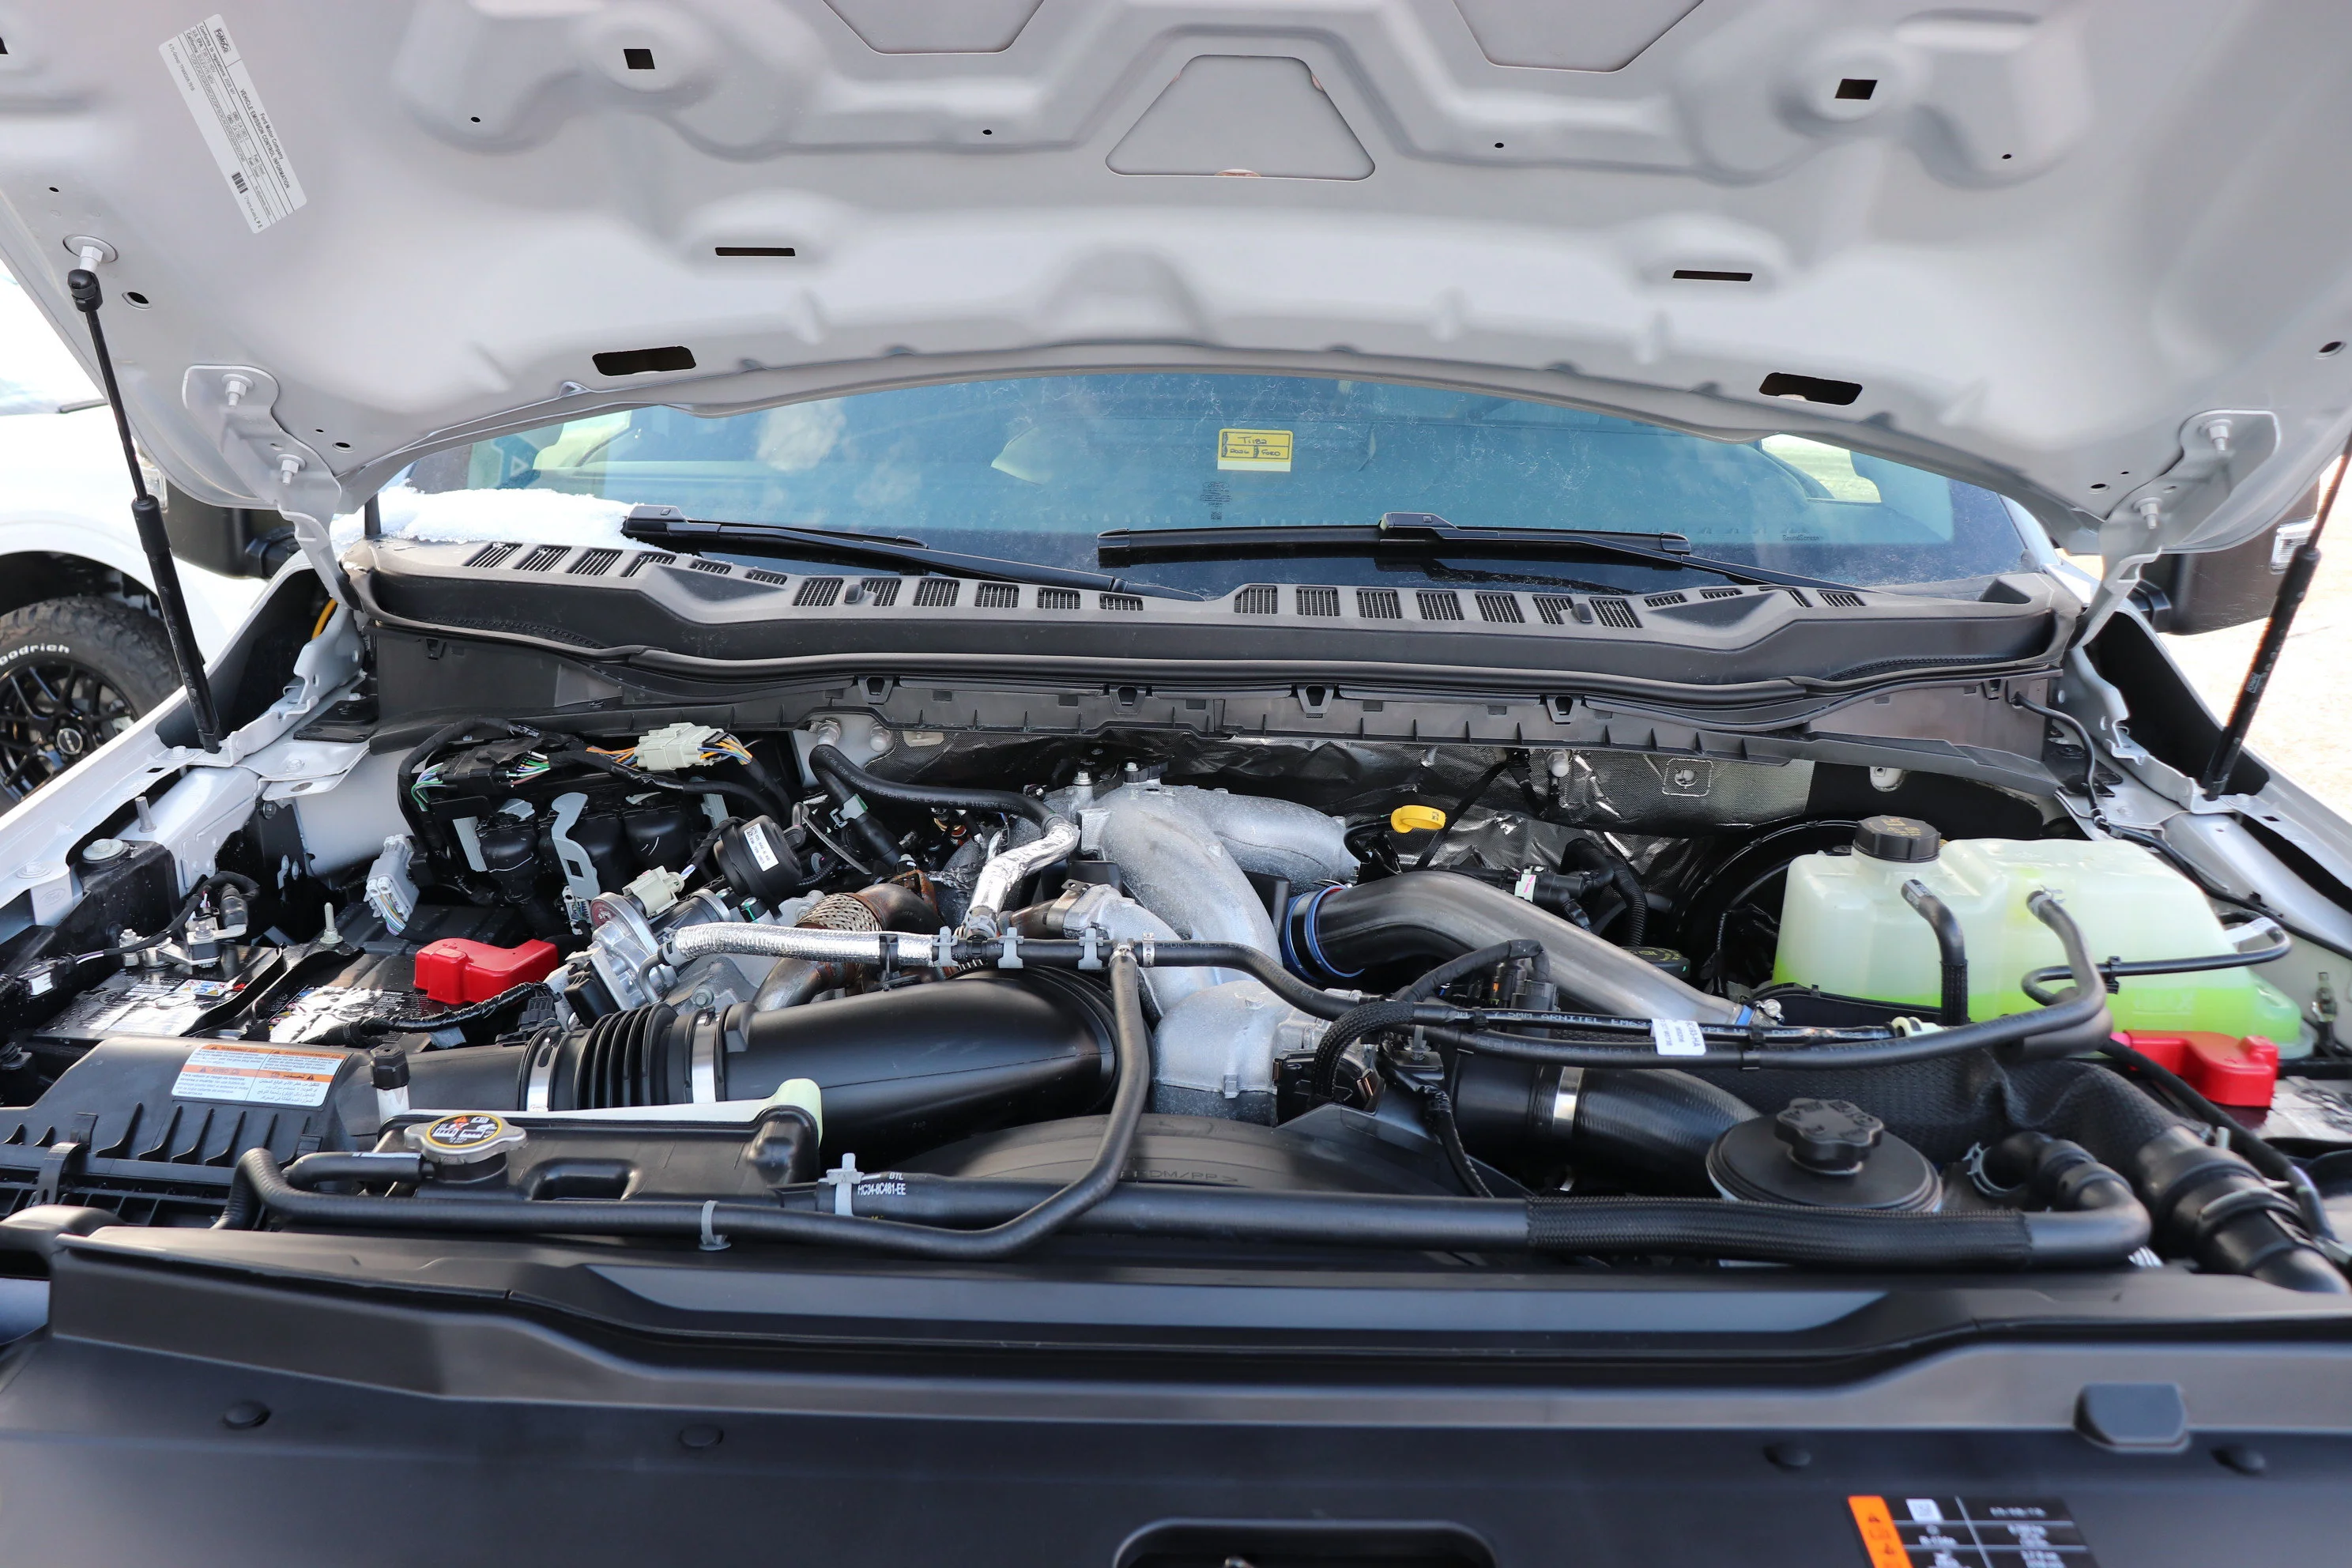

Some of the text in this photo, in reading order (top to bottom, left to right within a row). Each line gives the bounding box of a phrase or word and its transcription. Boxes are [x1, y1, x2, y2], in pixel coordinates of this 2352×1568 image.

[198, 24, 212, 47] Conforms
[214, 28, 230, 52] FoMoCo
[239, 89, 290, 189] VEHICLE EMISSION CONTROL INFORMATION
[259, 112, 285, 160] Ford Motor Company
[1540, 1014, 1602, 1023] ARNITEL
